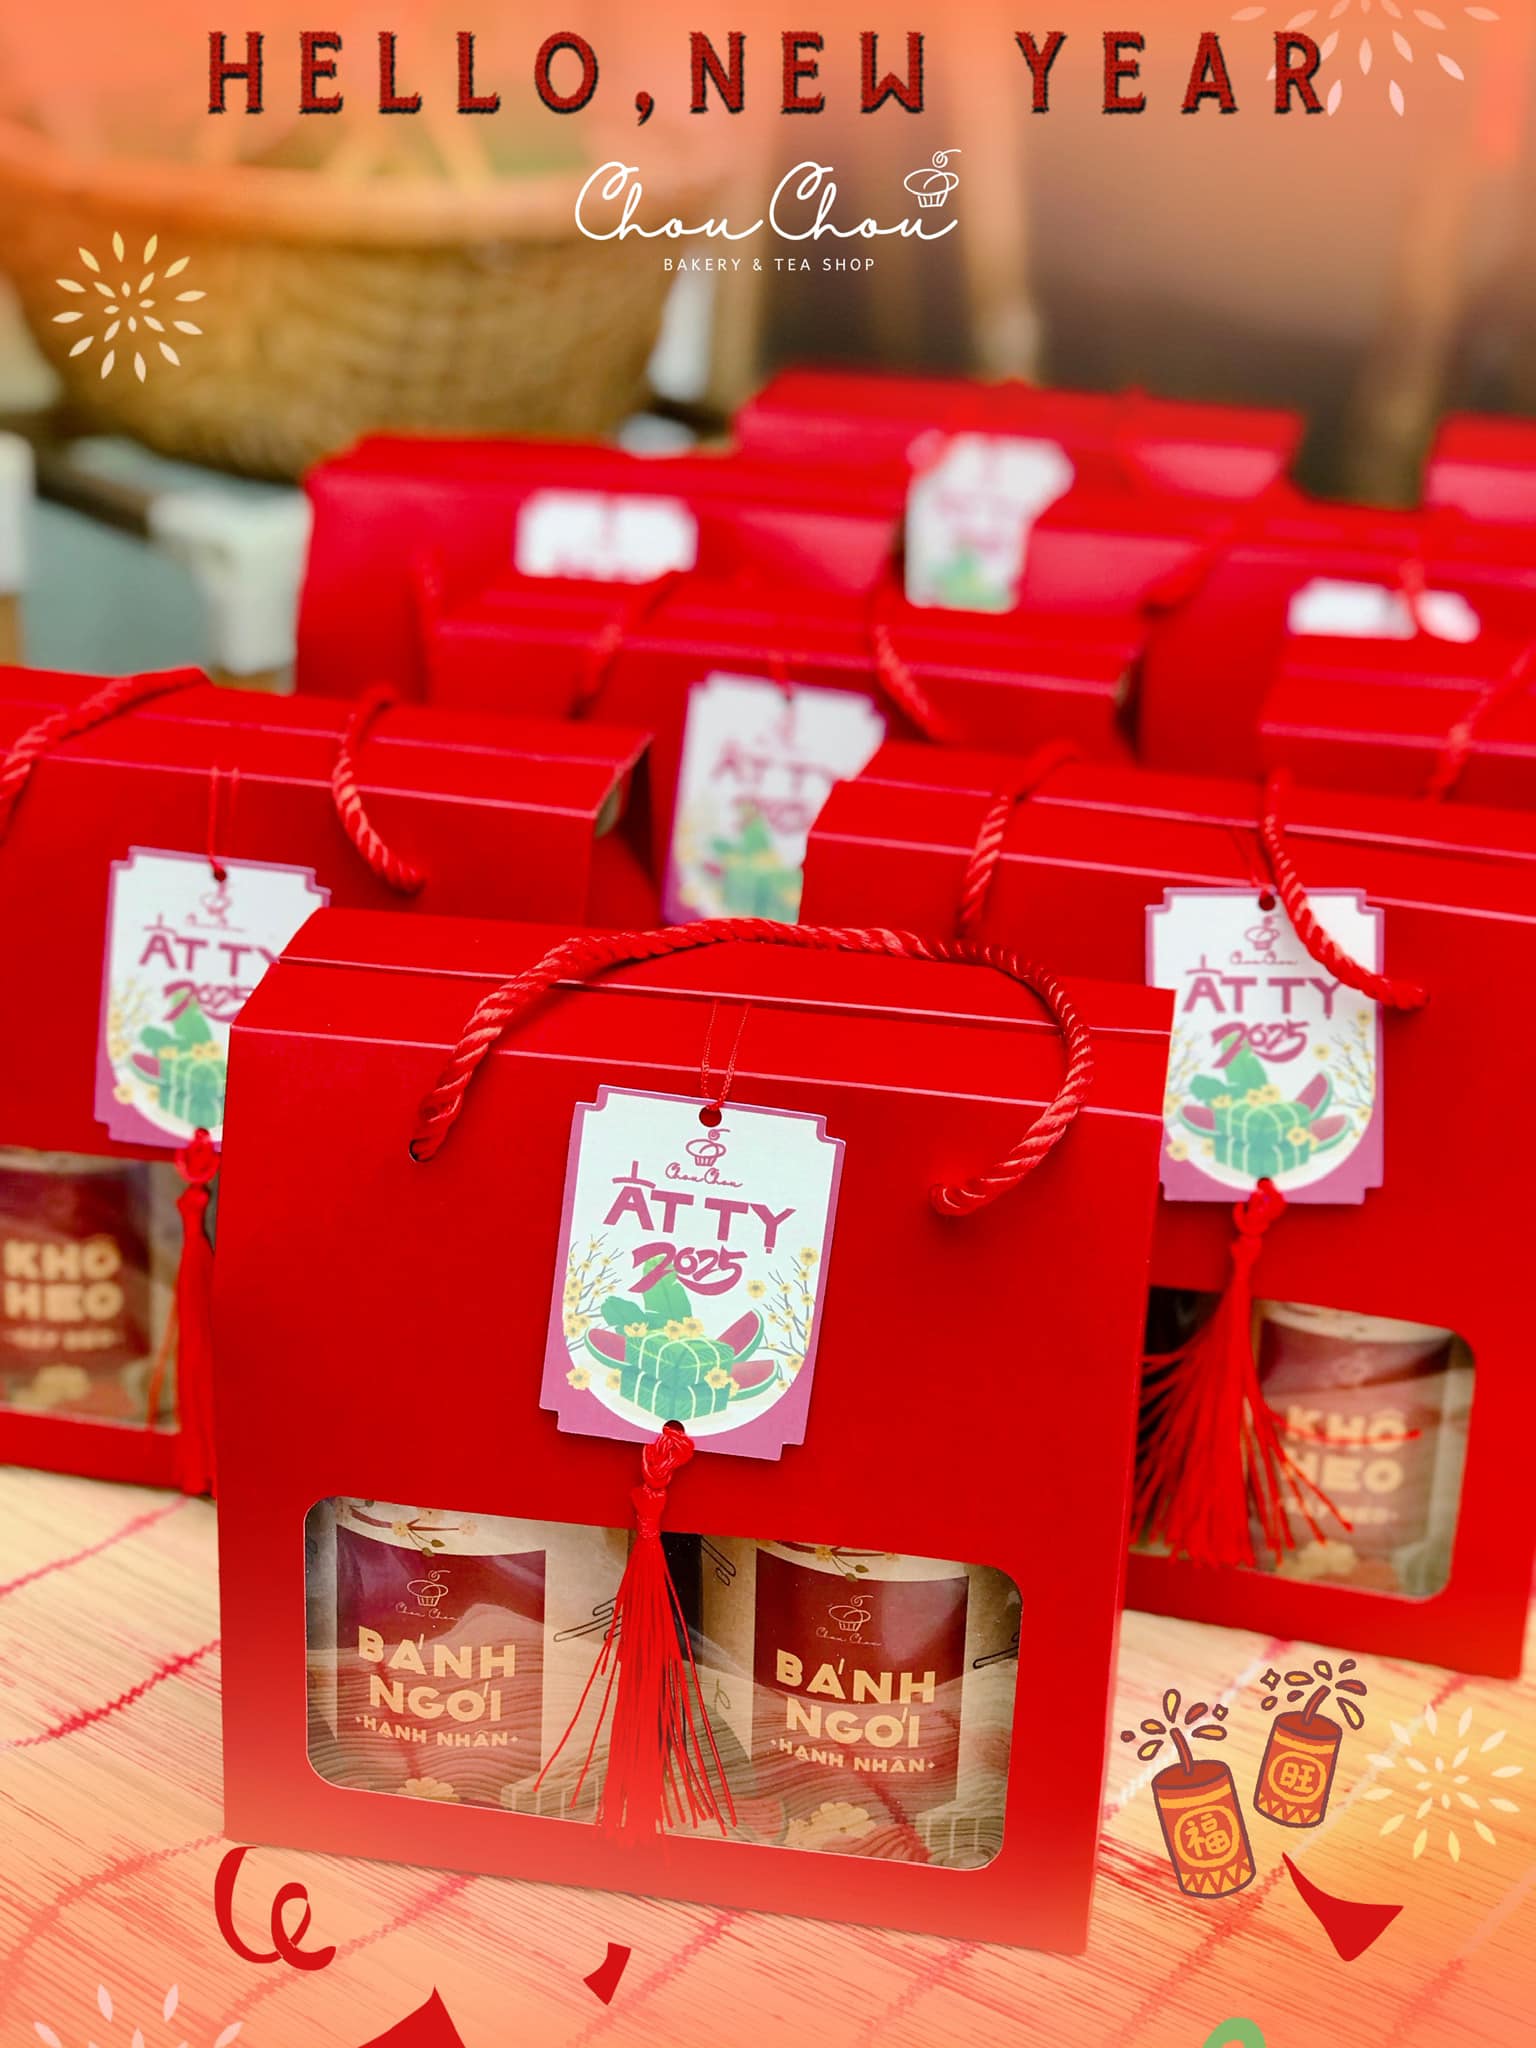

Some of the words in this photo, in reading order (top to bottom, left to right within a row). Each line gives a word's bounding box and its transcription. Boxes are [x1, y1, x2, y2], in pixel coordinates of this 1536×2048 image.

[1211, 1020, 1310, 1068] 2025
[628, 1241, 748, 1296] 2025
[4, 1281, 123, 1321] HEO
[358, 1625, 516, 1679] BÁNH
[776, 1649, 936, 1704] BÁNH
